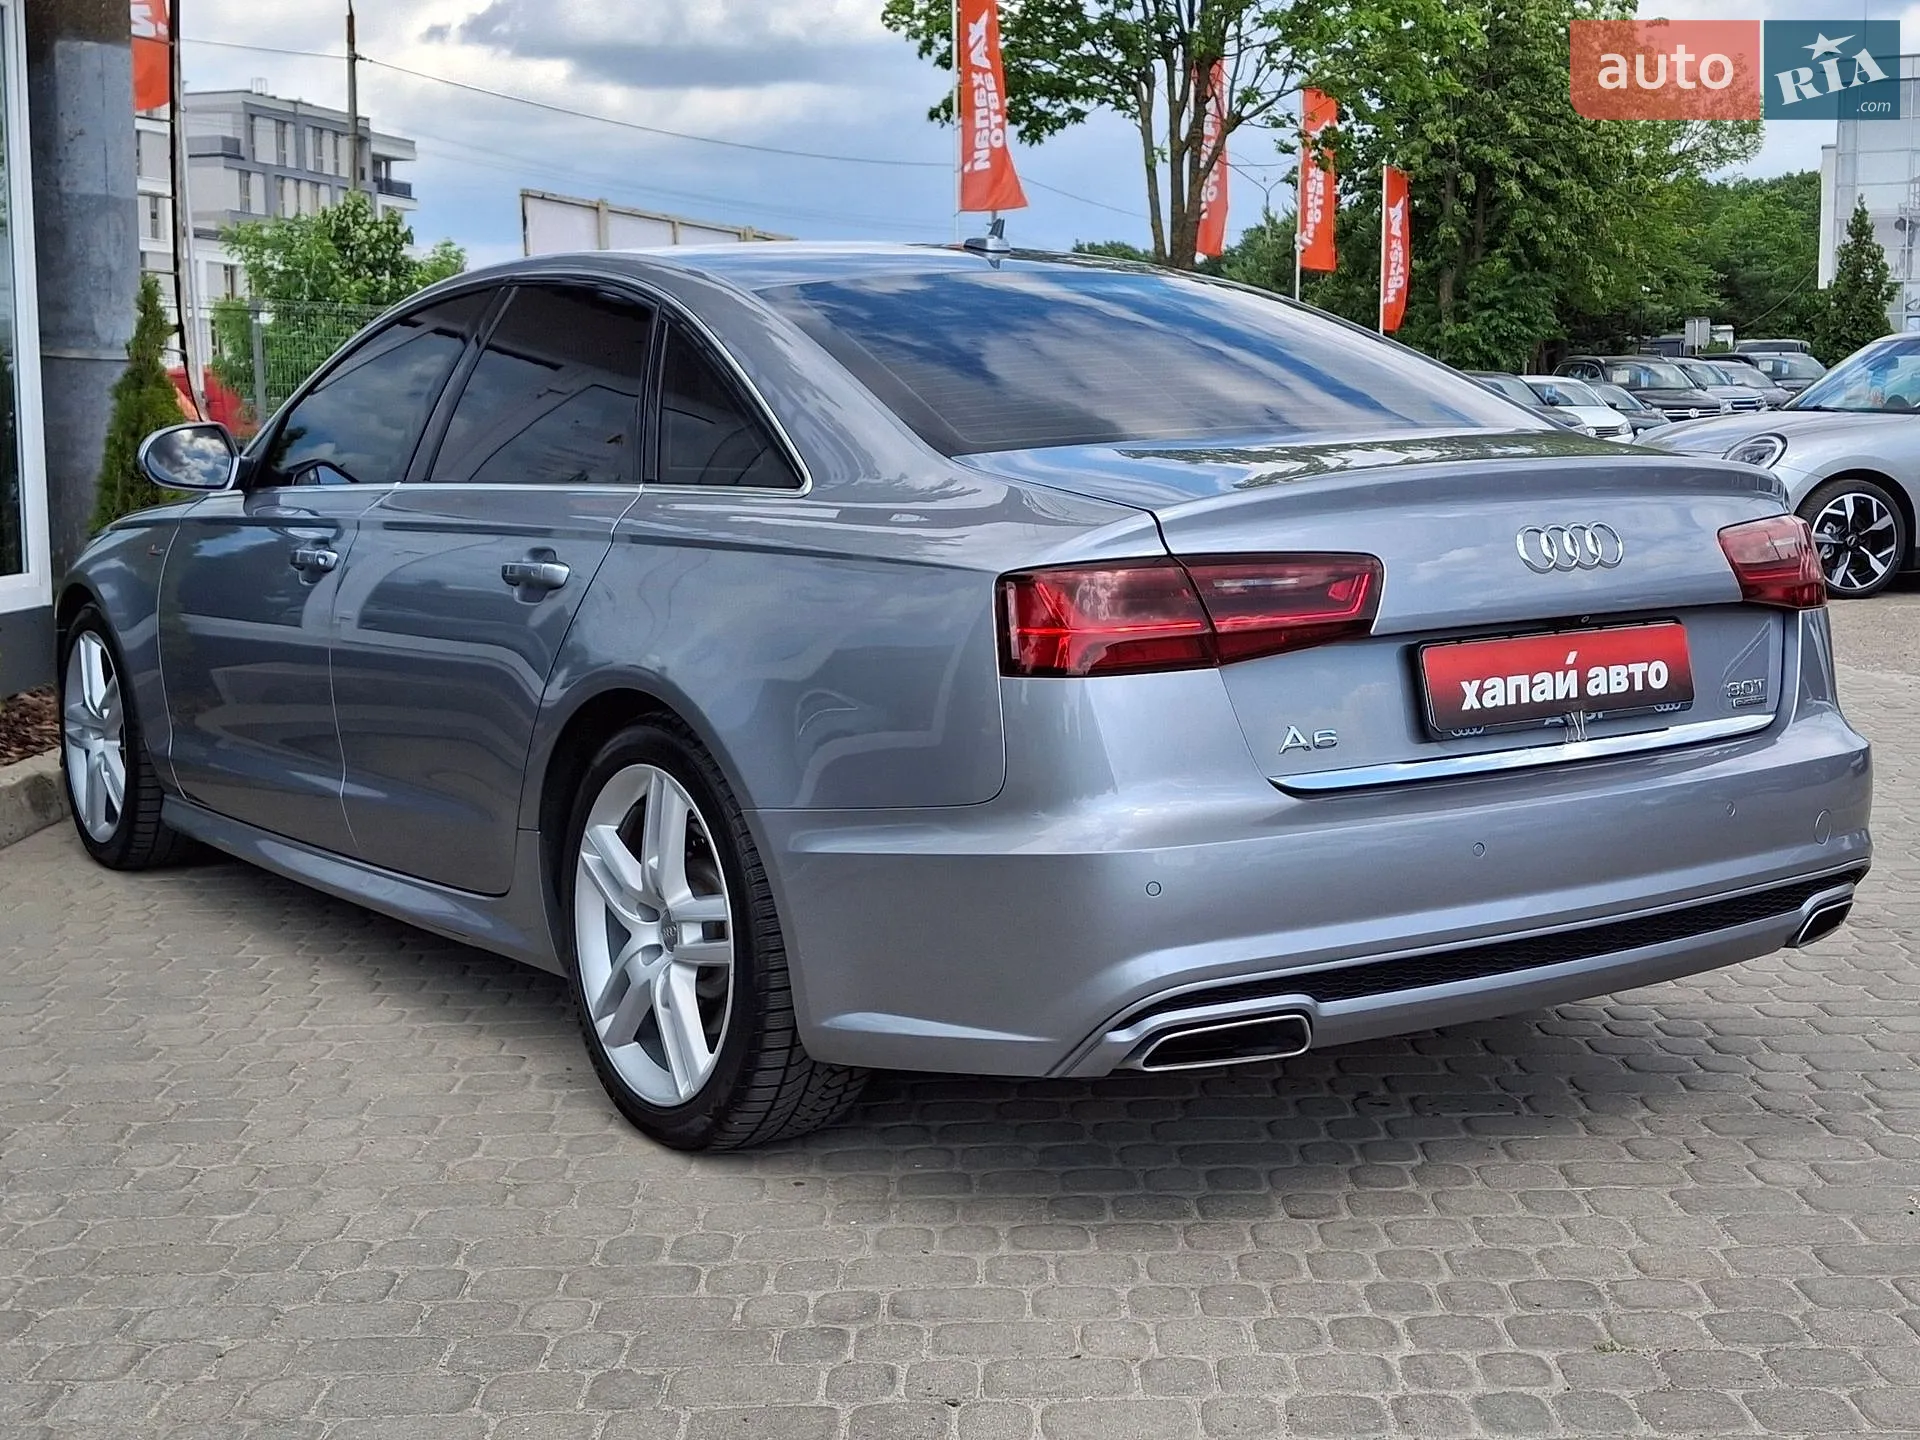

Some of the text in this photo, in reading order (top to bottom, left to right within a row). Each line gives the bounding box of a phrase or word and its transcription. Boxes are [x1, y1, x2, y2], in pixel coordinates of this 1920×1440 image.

[1460, 651, 1669, 711] хапай авто
[1279, 725, 1338, 754] A6
